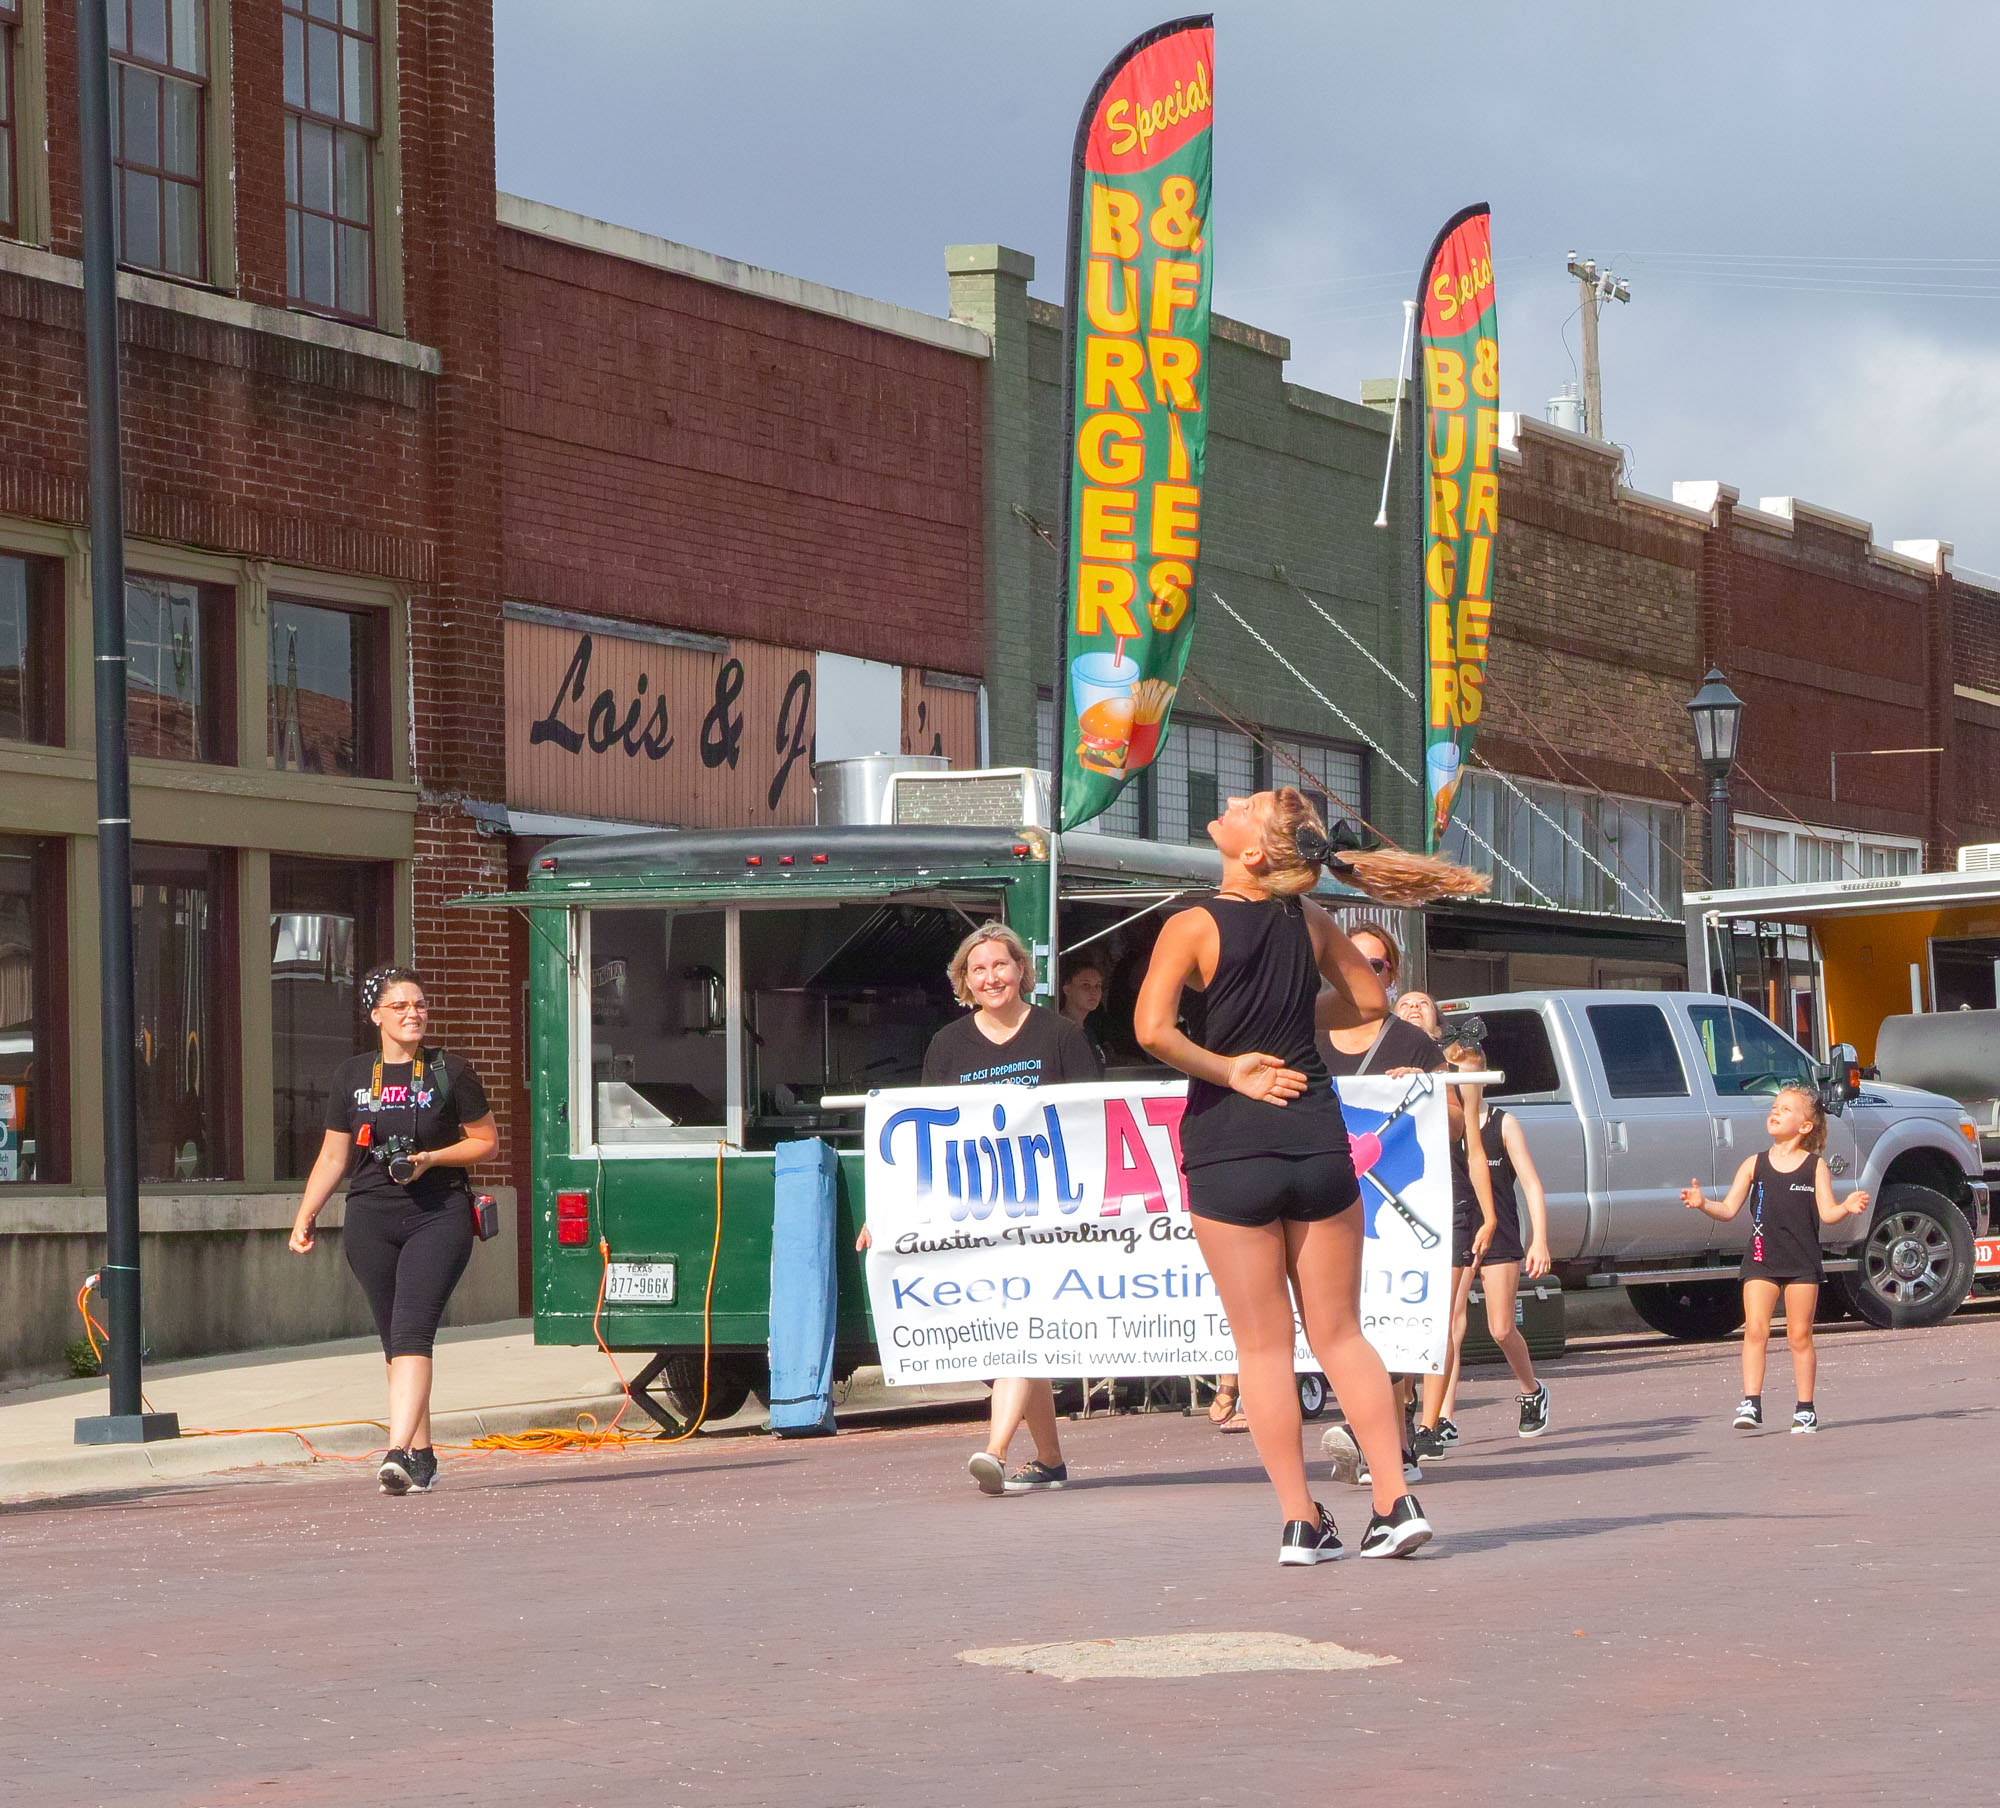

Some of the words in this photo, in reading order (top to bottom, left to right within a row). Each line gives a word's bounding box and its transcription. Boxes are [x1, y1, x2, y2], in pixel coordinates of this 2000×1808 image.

[1105, 61, 1211, 156] Special
[530, 634, 674, 760] Lois
[700, 658, 744, 770] &
[960, 1072, 972, 1083] THE
[973, 1069, 989, 1080] BEST
[990, 1060, 1042, 1077] PREPARATION
[381, 1086, 408, 1103] ATX
[880, 1103, 1083, 1224] Twirl
[895, 1229, 998, 1255] Austin
[1002, 1221, 1142, 1253] Twirling
[627, 1265, 653, 1273] TEXAS
[892, 1275, 1031, 1309] Keep
[893, 1317, 1019, 1350] Competitive
[1029, 1316, 1098, 1340] Baton
[1107, 1313, 1196, 1344] Twirling
[900, 1357, 929, 1373] For
[935, 1354, 978, 1371] more
[983, 1349, 1038, 1367] details
[1044, 1349, 1082, 1366] visit
[1089, 1347, 1238, 1365] www.twirlatx.co
